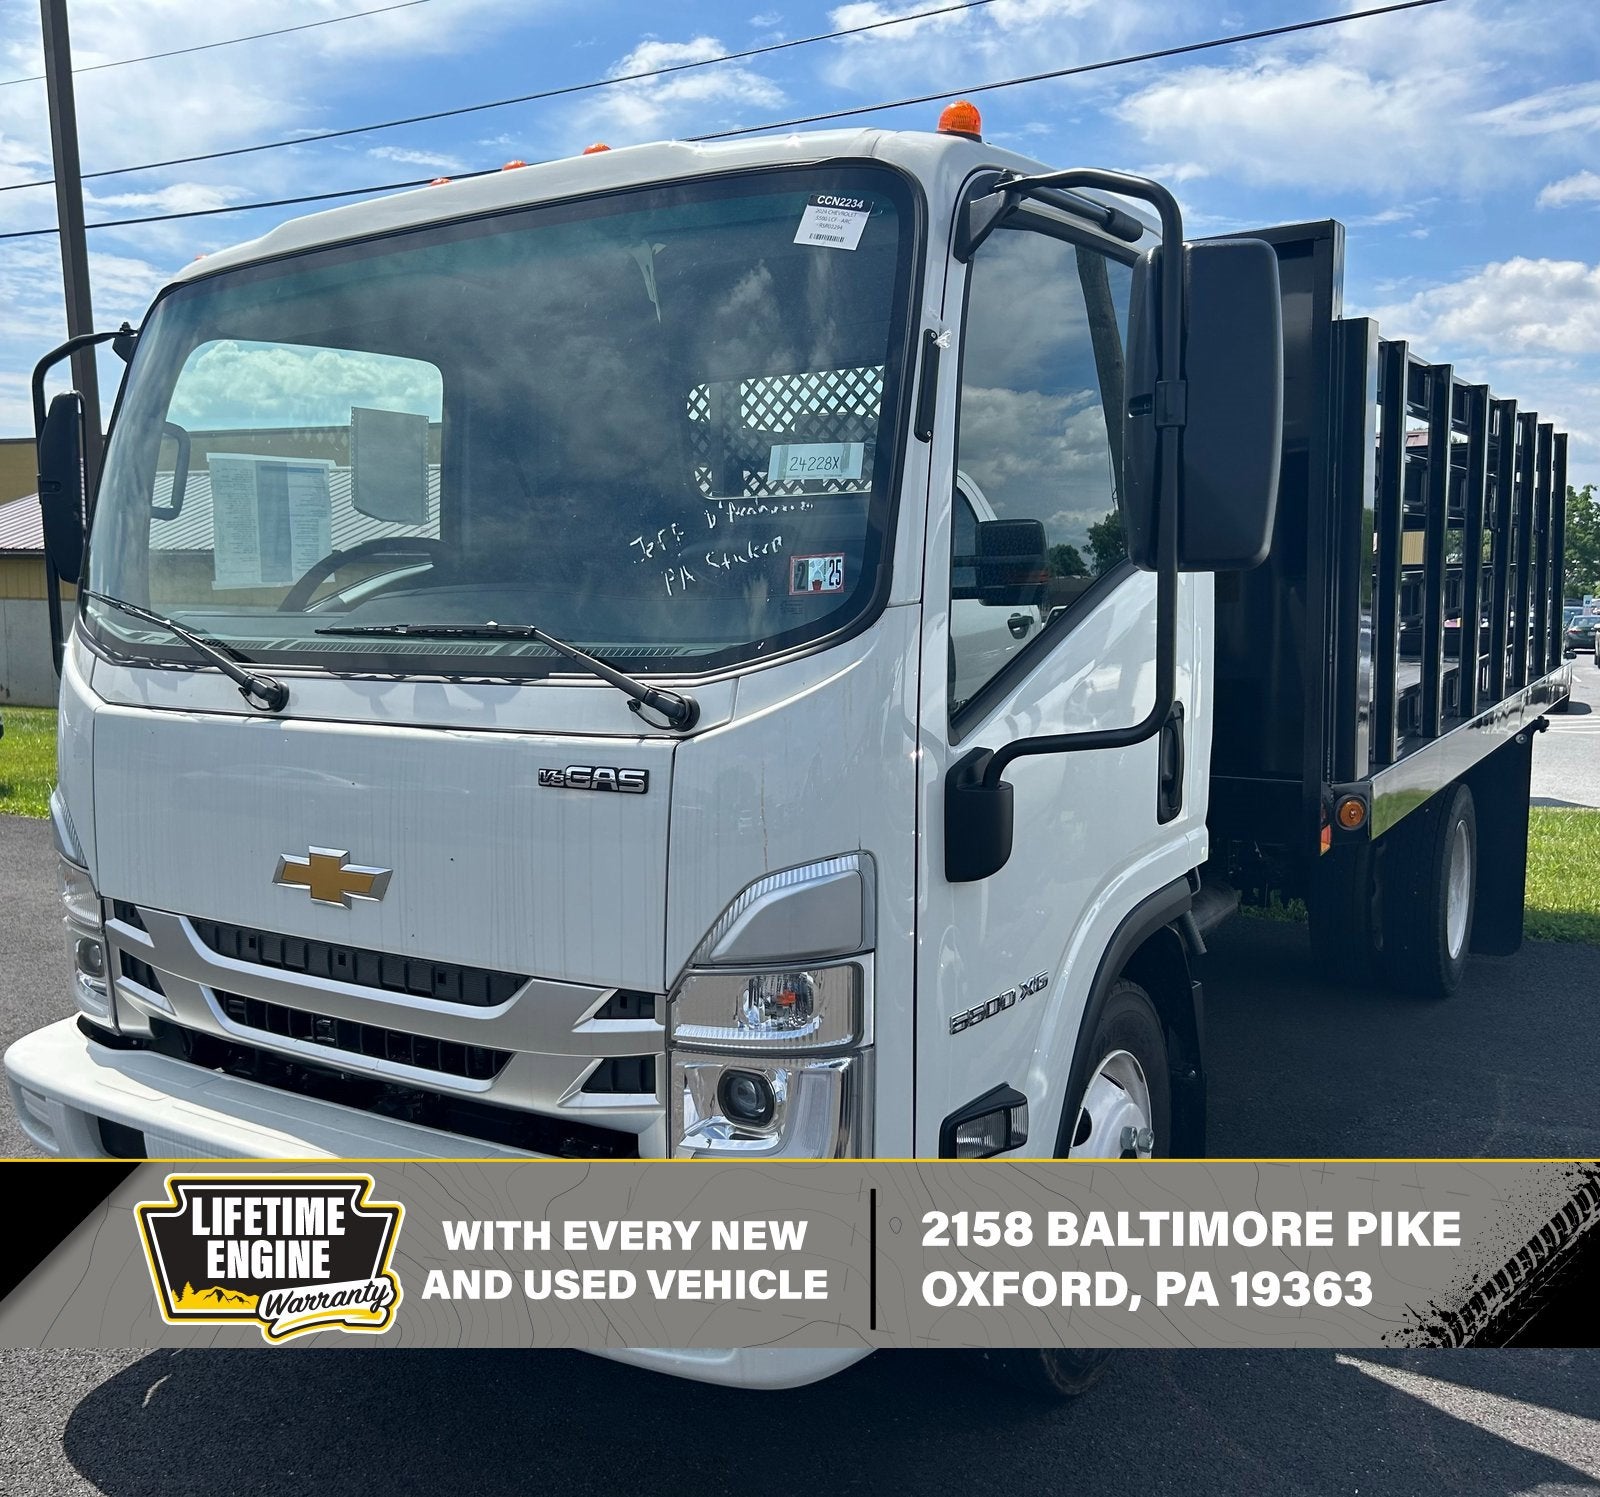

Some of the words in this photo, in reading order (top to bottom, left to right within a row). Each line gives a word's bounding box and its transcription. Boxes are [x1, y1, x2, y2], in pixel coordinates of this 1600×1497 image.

[817, 195, 864, 209] CCN2234
[828, 209, 857, 218] CHEVROLET
[789, 456, 841, 472] 24228X
[828, 559, 842, 586] 25
[950, 987, 1017, 1035] 5500
